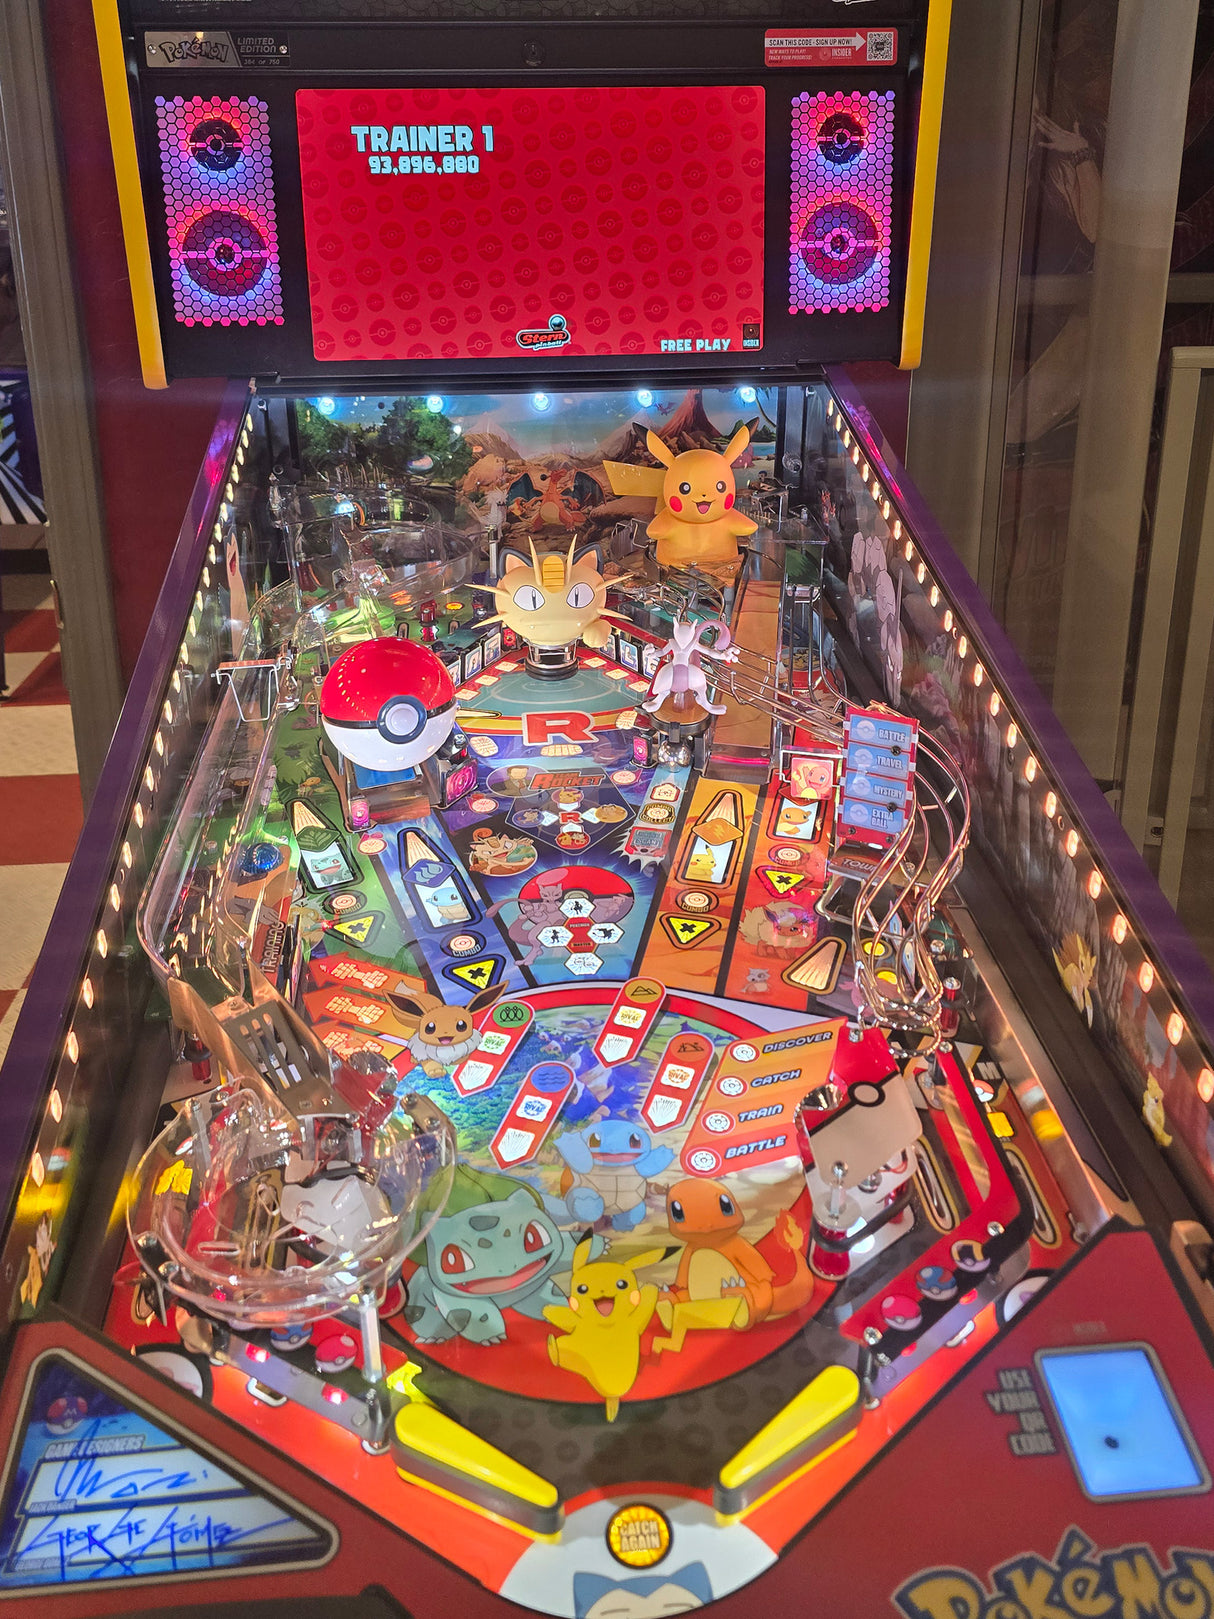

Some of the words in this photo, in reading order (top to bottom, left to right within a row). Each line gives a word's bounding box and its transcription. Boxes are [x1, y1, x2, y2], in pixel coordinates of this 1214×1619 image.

[238, 37, 275, 45] LIMITED
[768, 39, 784, 47] SCAN
[797, 38, 812, 46] CODE
[816, 38, 828, 46] SIGN
[240, 45, 277, 53] EDITION
[831, 48, 852, 56] INSIDER
[350, 125, 474, 152] TRAINER
[481, 125, 494, 152] 1
[368, 155, 480, 176] 93,896,880
[522, 333, 563, 345] Stern
[660, 338, 692, 352] FREE
[695, 338, 731, 351] PLAY
[878, 729, 906, 743] BATTLE
[876, 755, 903, 770] TRAVEL
[530, 774, 604, 790] ROCKET
[873, 784, 903, 800] MYSTERY
[872, 808, 894, 821] EXTRA
[871, 817, 888, 829] BALL
[681, 902, 710, 913] COMBO
[452, 944, 482, 957] COMBO
[762, 1031, 833, 1053] DISCOVER
[751, 1068, 802, 1088] CATCH
[738, 1103, 784, 1122] TRAIN
[724, 1135, 787, 1159] BATTLE
[999, 1368, 1032, 1389] USE
[620, 1520, 658, 1536] CATCH
[621, 1533, 660, 1552] AGAIN
